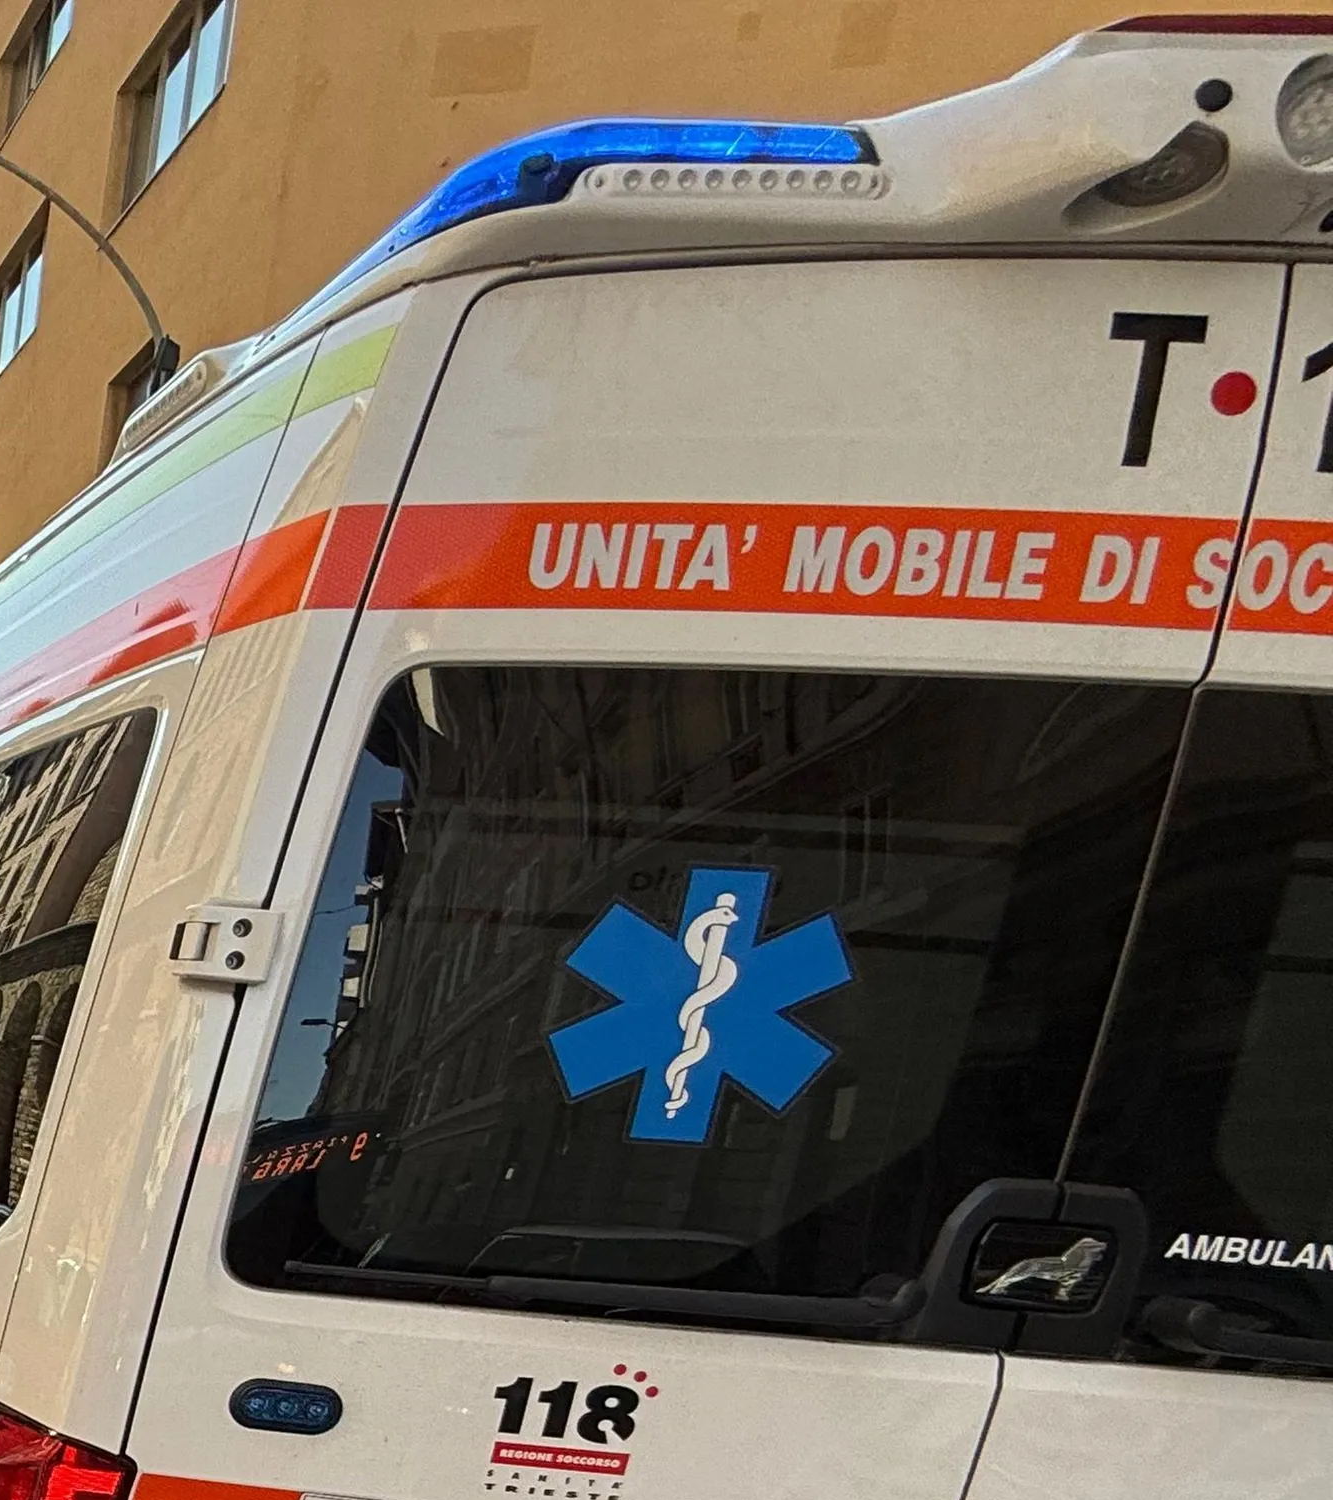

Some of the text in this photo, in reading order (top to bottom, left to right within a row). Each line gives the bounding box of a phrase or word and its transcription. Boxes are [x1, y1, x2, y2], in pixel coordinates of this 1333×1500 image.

[782, 525, 1056, 601] MOBILE
[1079, 534, 1161, 605] DI
[1186, 537, 1333, 614] SOC
[1164, 1232, 1333, 1271] AMBULAN
[494, 1377, 640, 1444] 118
[499, 1448, 621, 1469] REGIONE SOCCORSO
